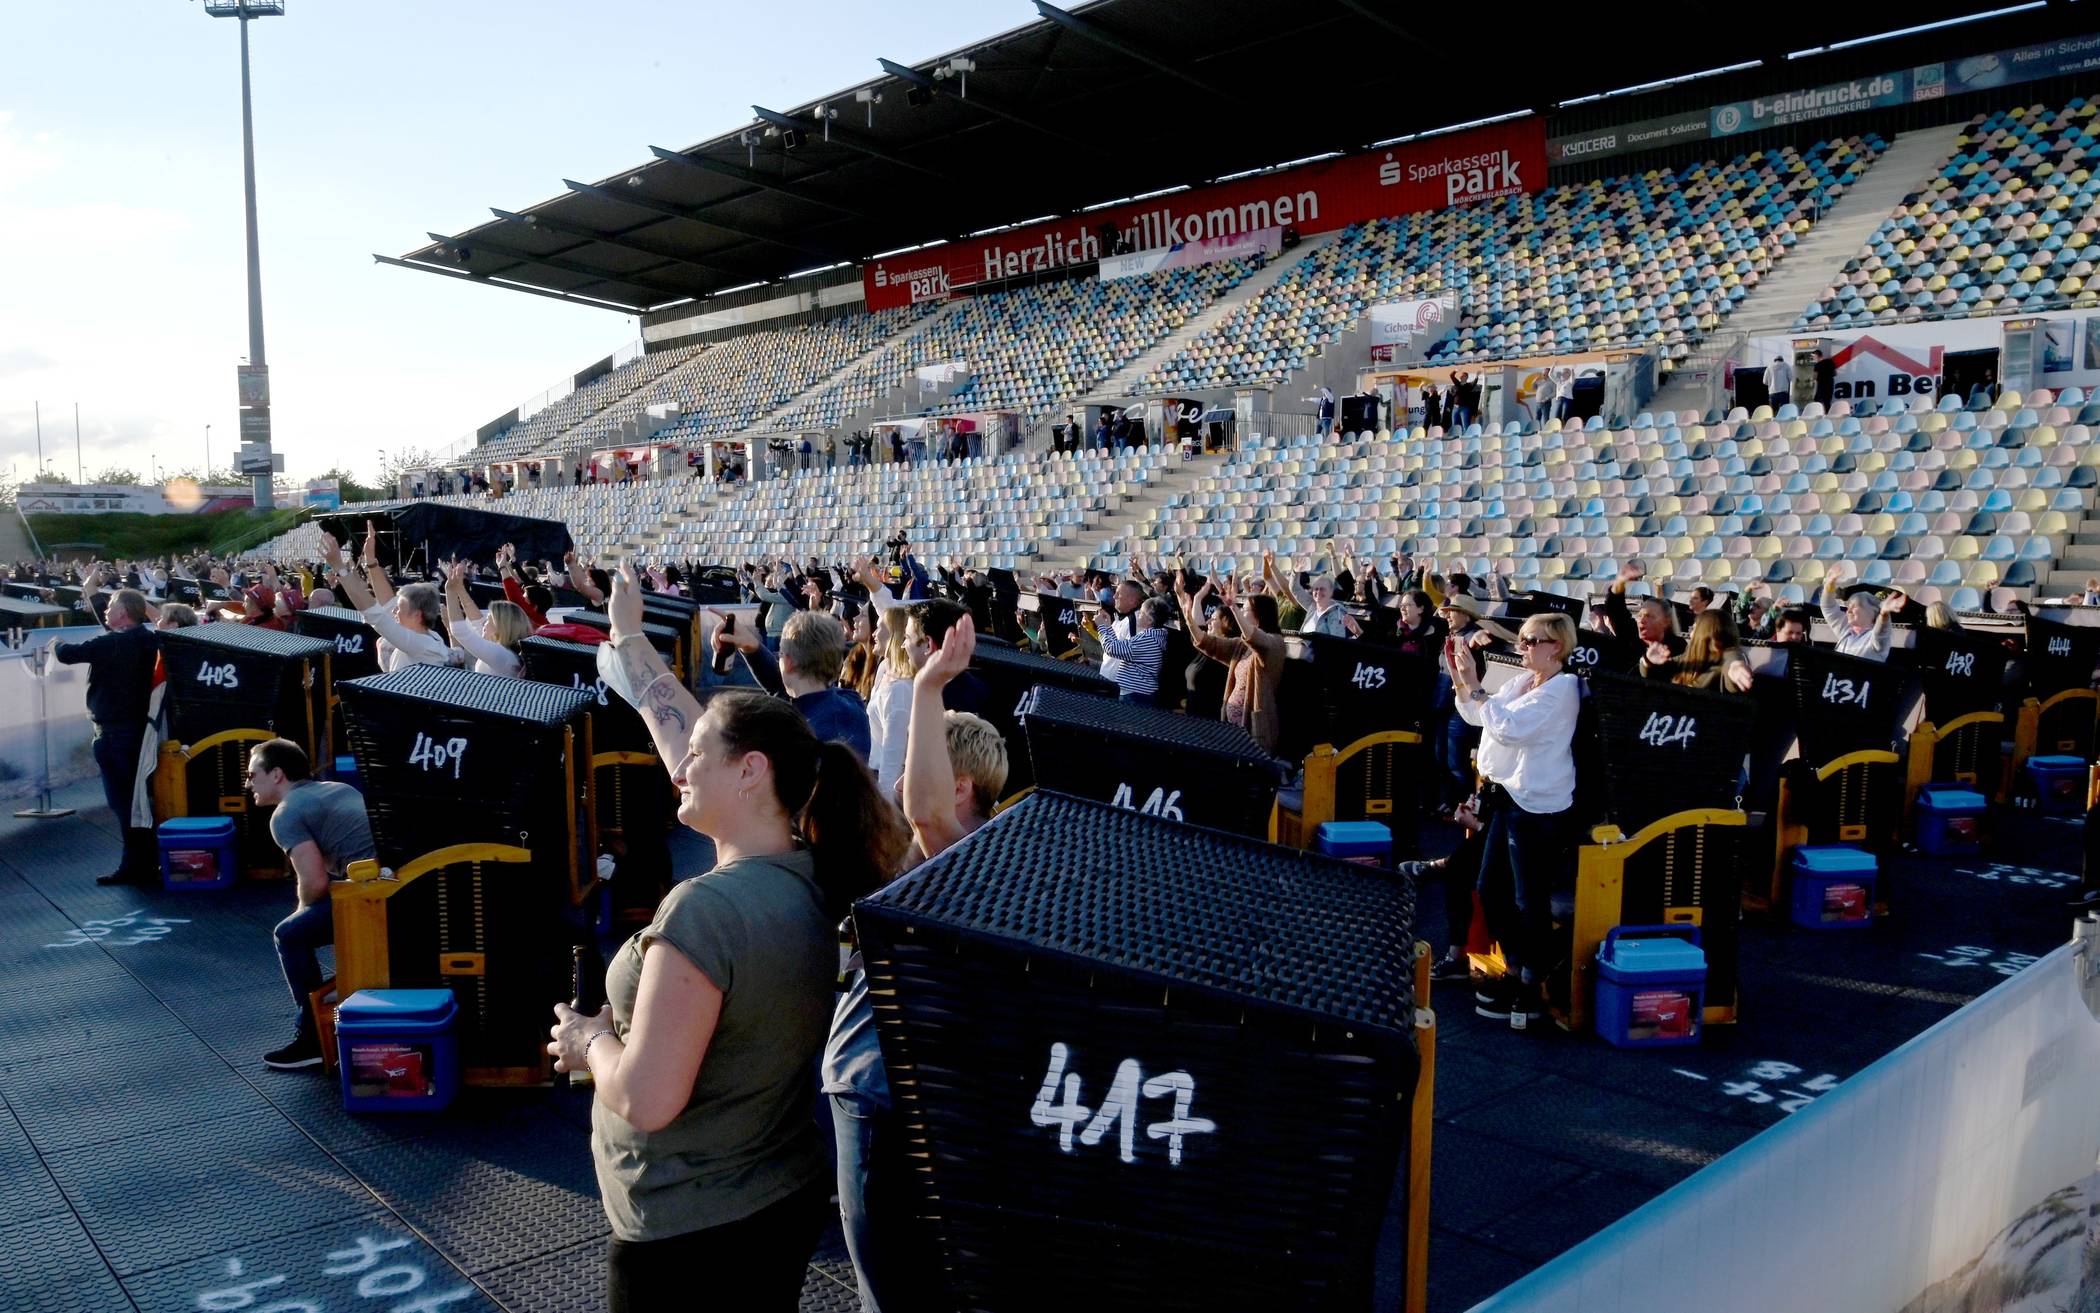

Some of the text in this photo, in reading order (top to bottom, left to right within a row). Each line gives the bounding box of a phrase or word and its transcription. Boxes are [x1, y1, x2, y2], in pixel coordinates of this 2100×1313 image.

[2012, 49, 2041, 63] Alles
[2044, 46, 2055, 57] in
[1752, 76, 1894, 119] b-eindruck.de
[1915, 87, 1944, 100] BASI
[1774, 99, 1871, 126] DIE TEXTILDRUCKEREI
[1562, 120, 1707, 158] KYOCERA Document Solutions
[1408, 151, 1500, 183] Sparkassen
[1447, 149, 1522, 206] park
[1454, 186, 1523, 204] MÖNCHENGLADBACH
[983, 226, 1099, 280] Herzlich
[889, 266, 939, 287] Sparkassen
[911, 265, 950, 303] park
[1384, 322, 1414, 334] Cichon
[1057, 608, 1076, 625] 42
[334, 633, 364, 654] 402
[2048, 636, 2072, 657] 444
[196, 661, 240, 689] 403
[1351, 661, 1387, 690] 423
[1945, 650, 1976, 677] 438
[1821, 672, 1871, 711] 431
[1639, 711, 1697, 751] 424
[408, 731, 468, 780] 409
[1030, 1041, 1218, 1166] 417
